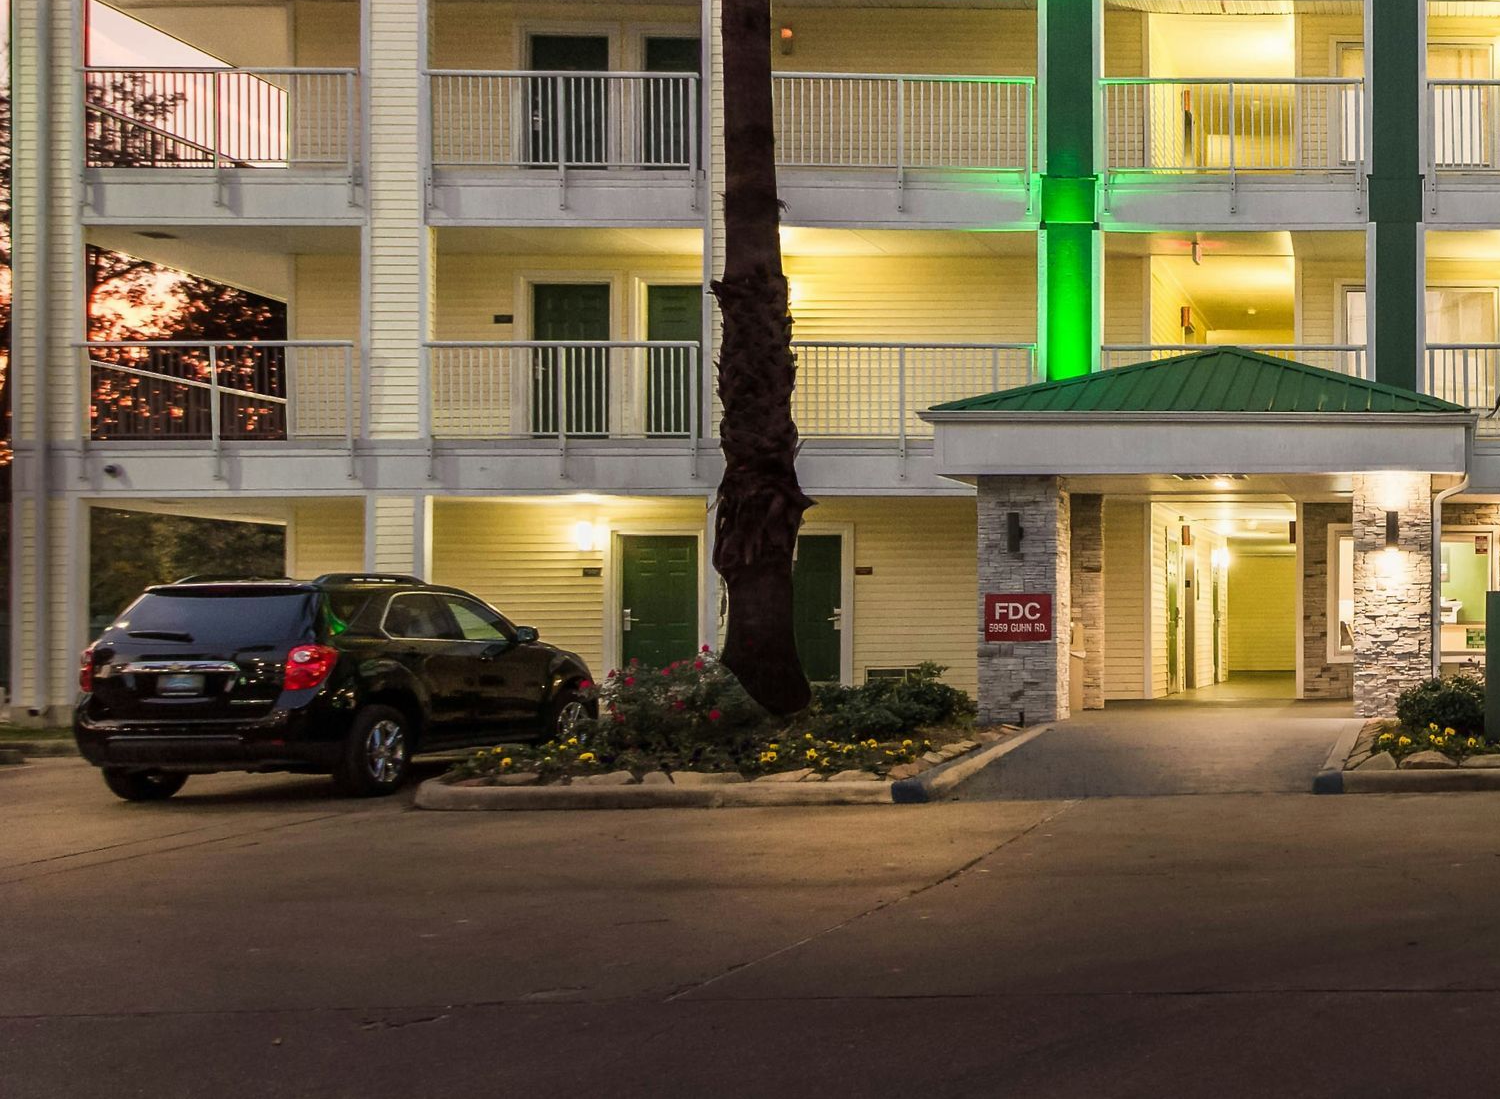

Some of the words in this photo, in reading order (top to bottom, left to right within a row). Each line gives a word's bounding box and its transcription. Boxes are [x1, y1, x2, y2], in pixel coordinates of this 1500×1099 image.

[994, 602, 1040, 620] FDC
[988, 623, 1008, 633] 5959
[1034, 623, 1047, 633] RD.
